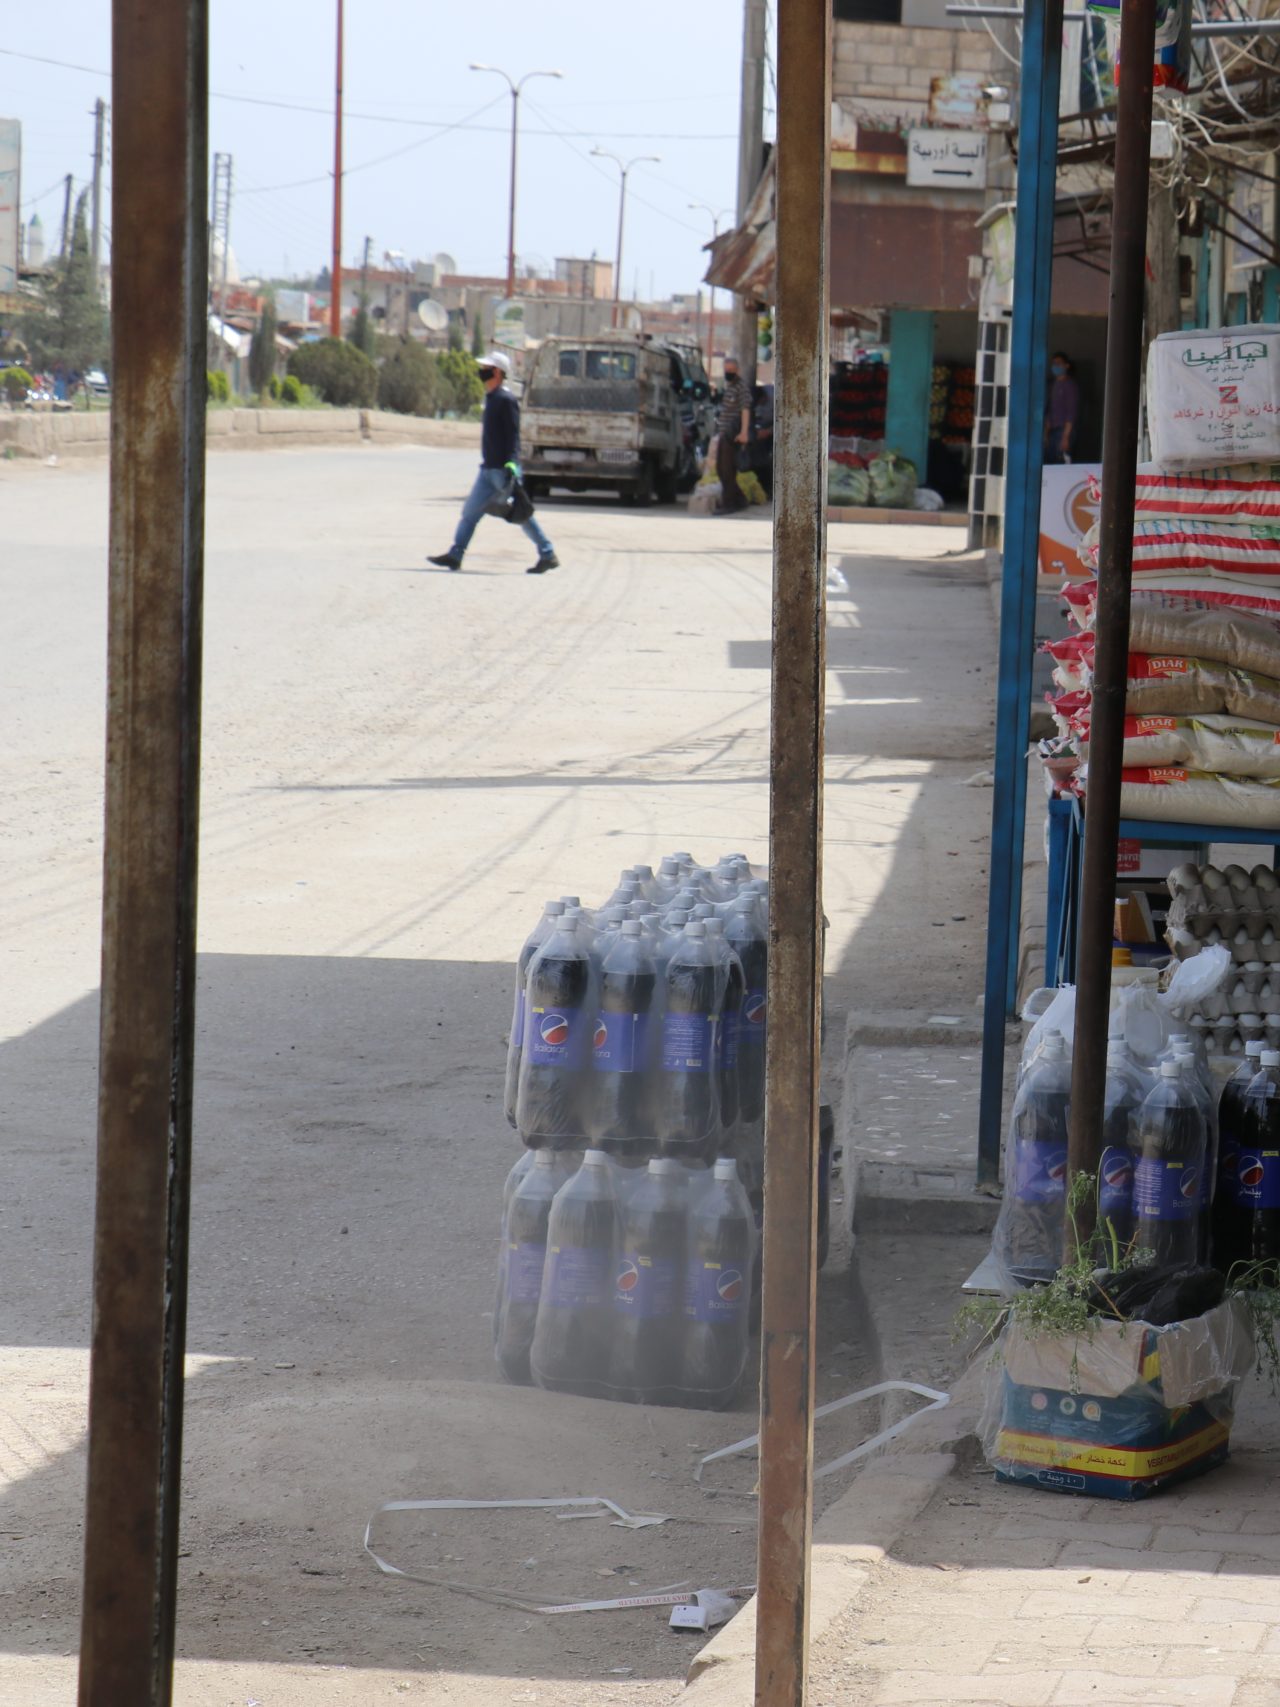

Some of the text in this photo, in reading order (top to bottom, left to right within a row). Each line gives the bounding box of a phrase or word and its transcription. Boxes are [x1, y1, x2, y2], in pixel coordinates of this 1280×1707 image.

[952, 136, 986, 163] ألبسة
[1152, 658, 1185, 670] DIAR
[1141, 717, 1173, 728] DIAR
[1152, 769, 1185, 778] DIAR
